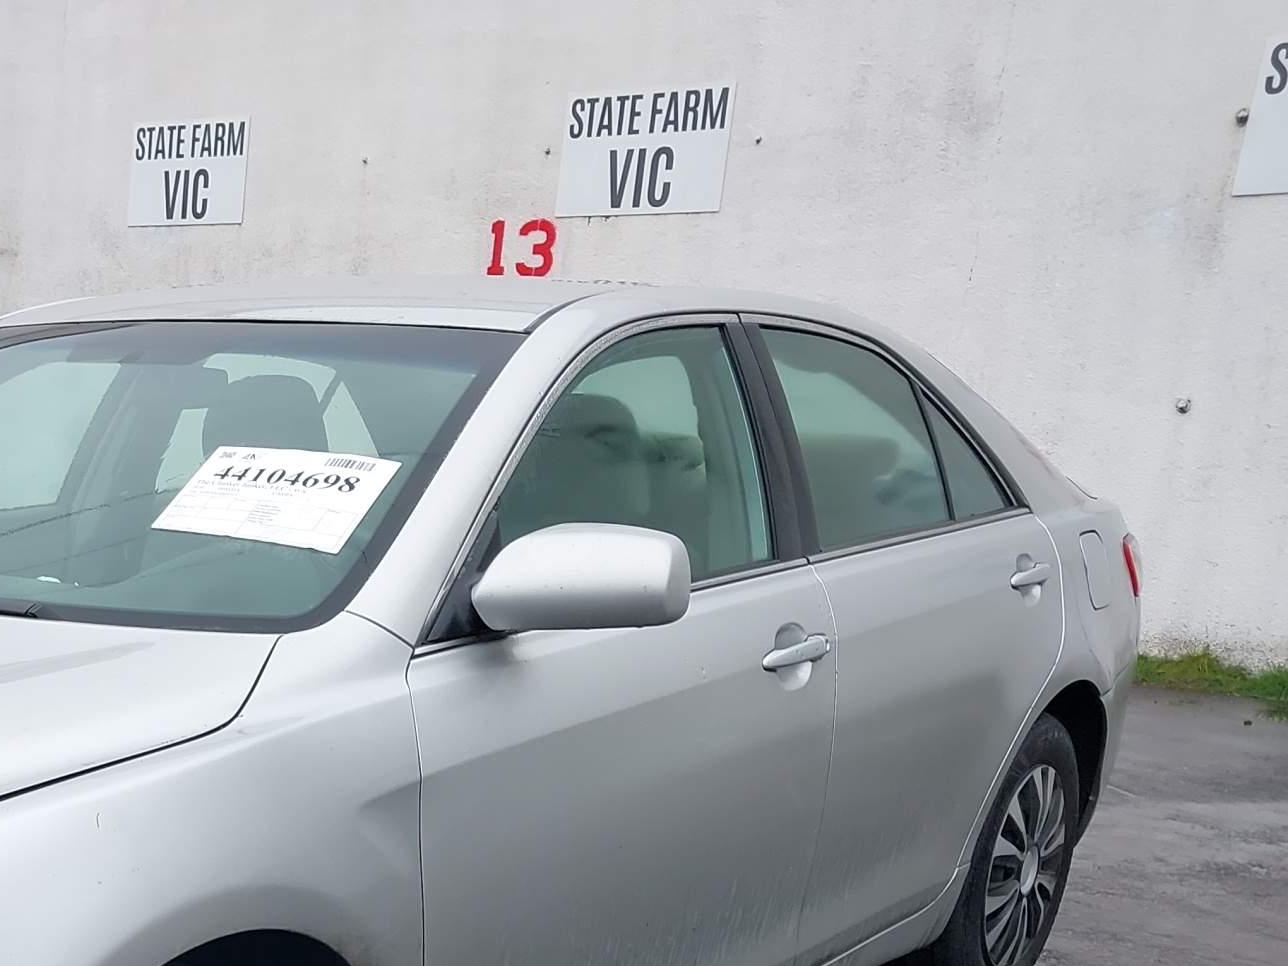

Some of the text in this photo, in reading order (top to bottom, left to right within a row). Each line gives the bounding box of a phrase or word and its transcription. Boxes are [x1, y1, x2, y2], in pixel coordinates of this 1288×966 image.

[570, 87, 729, 138] STATE FARM
[136, 122, 245, 160] STATE FARM
[165, 169, 209, 219] VIC
[610, 147, 673, 208] VIC
[486, 219, 557, 277] 13
[213, 465, 360, 493] 44104698
